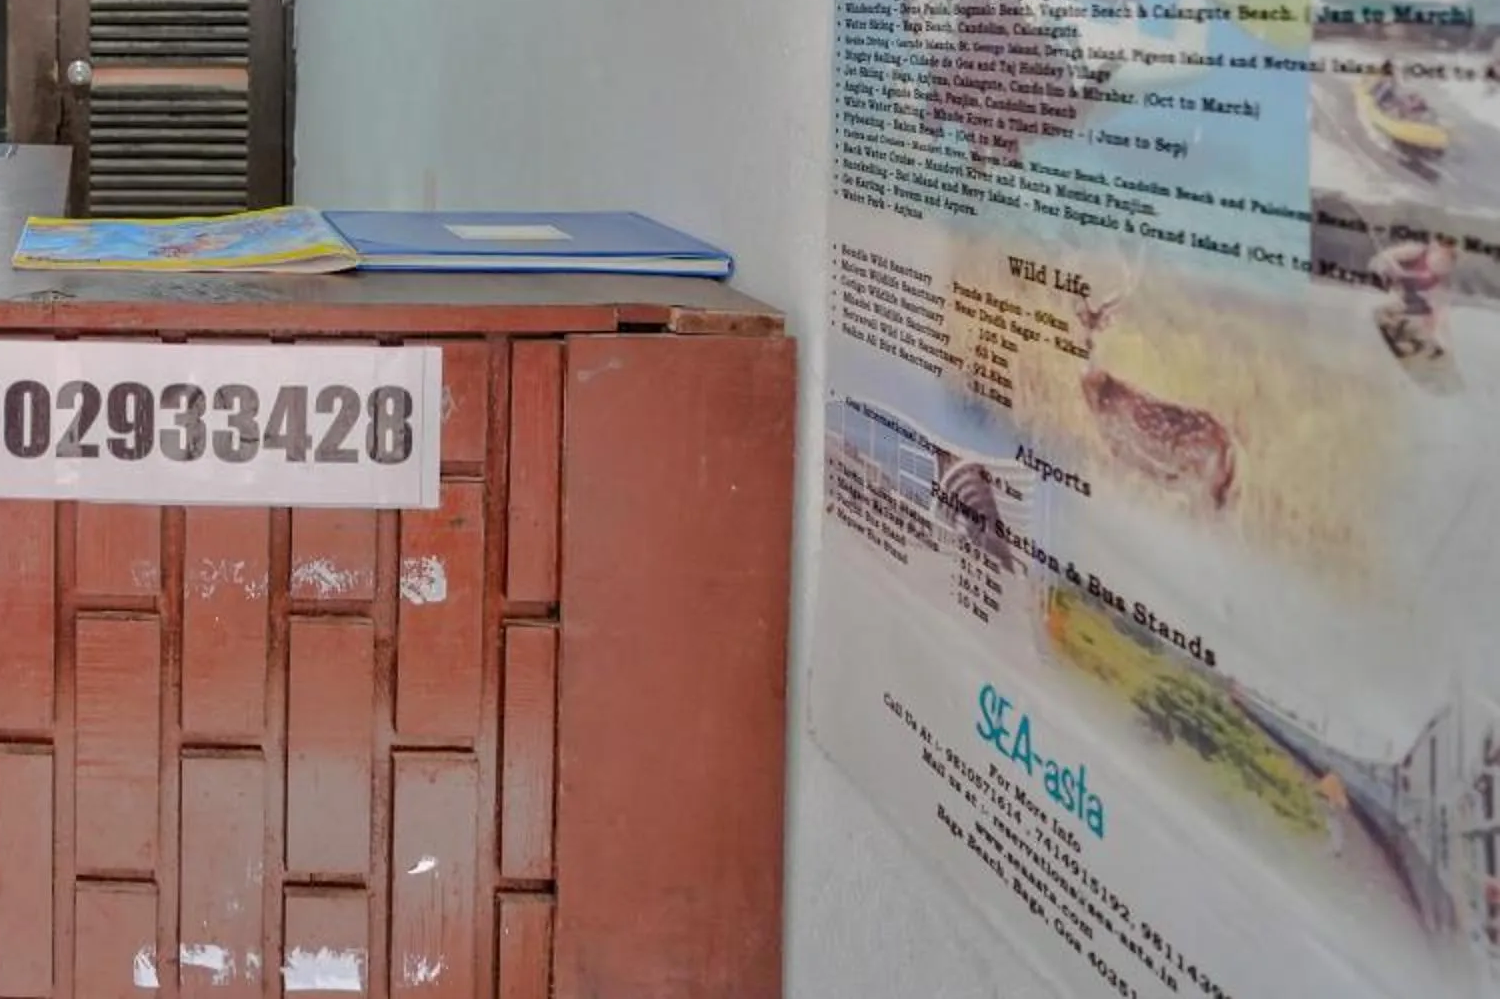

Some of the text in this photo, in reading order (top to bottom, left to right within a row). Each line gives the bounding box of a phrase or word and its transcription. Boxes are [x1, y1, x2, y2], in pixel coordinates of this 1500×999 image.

[1008, 255, 1093, 300] Wild Life
[1015, 442, 1092, 497] Airports
[995, 517, 1061, 575] Station
[1066, 561, 1083, 586] &
[1088, 572, 1127, 613] Bus
[1133, 600, 1217, 668] Stands
[989, 762, 1083, 855] For More Info
